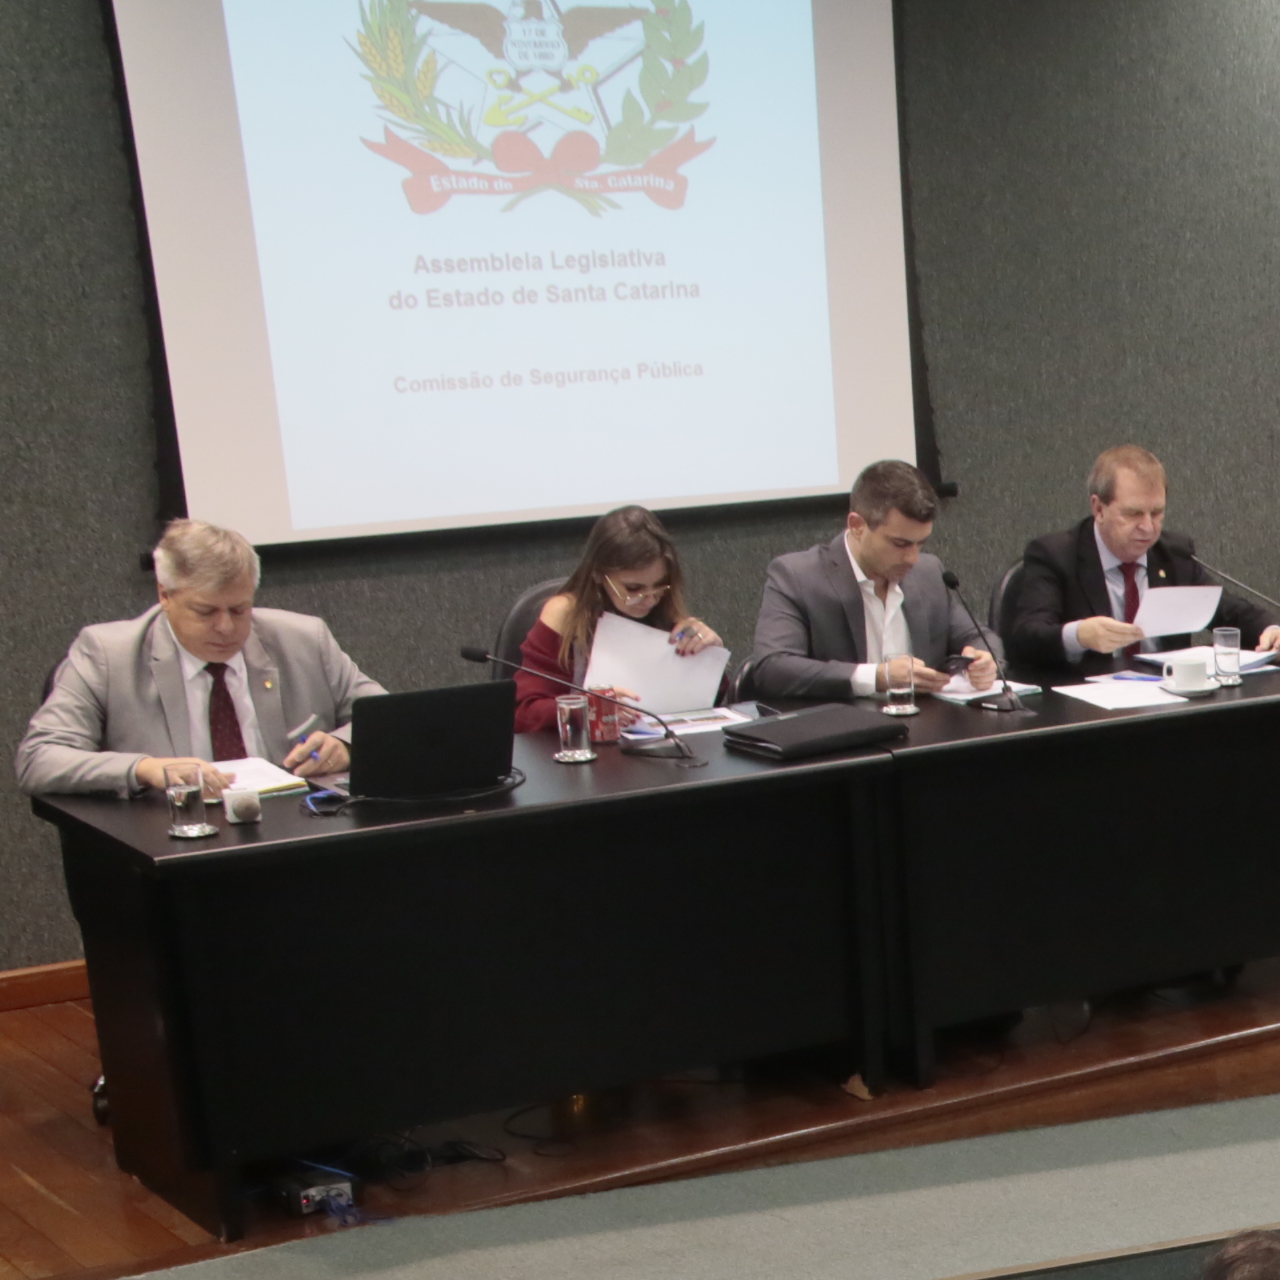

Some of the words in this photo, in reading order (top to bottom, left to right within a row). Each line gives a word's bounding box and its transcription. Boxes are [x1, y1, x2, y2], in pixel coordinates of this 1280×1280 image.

[429, 174, 489, 192] Estado
[607, 172, 675, 192] Catarina
[413, 252, 543, 275] Assembleia
[550, 248, 667, 274] Legislativa
[389, 291, 418, 310] do
[426, 287, 505, 309] Estado
[512, 286, 538, 306] de
[546, 283, 607, 304] Santa
[613, 280, 701, 301] Catarina
[393, 371, 494, 394] Comissão
[500, 370, 523, 388] de
[529, 364, 631, 388] Segurança
[637, 361, 704, 379] Pública
